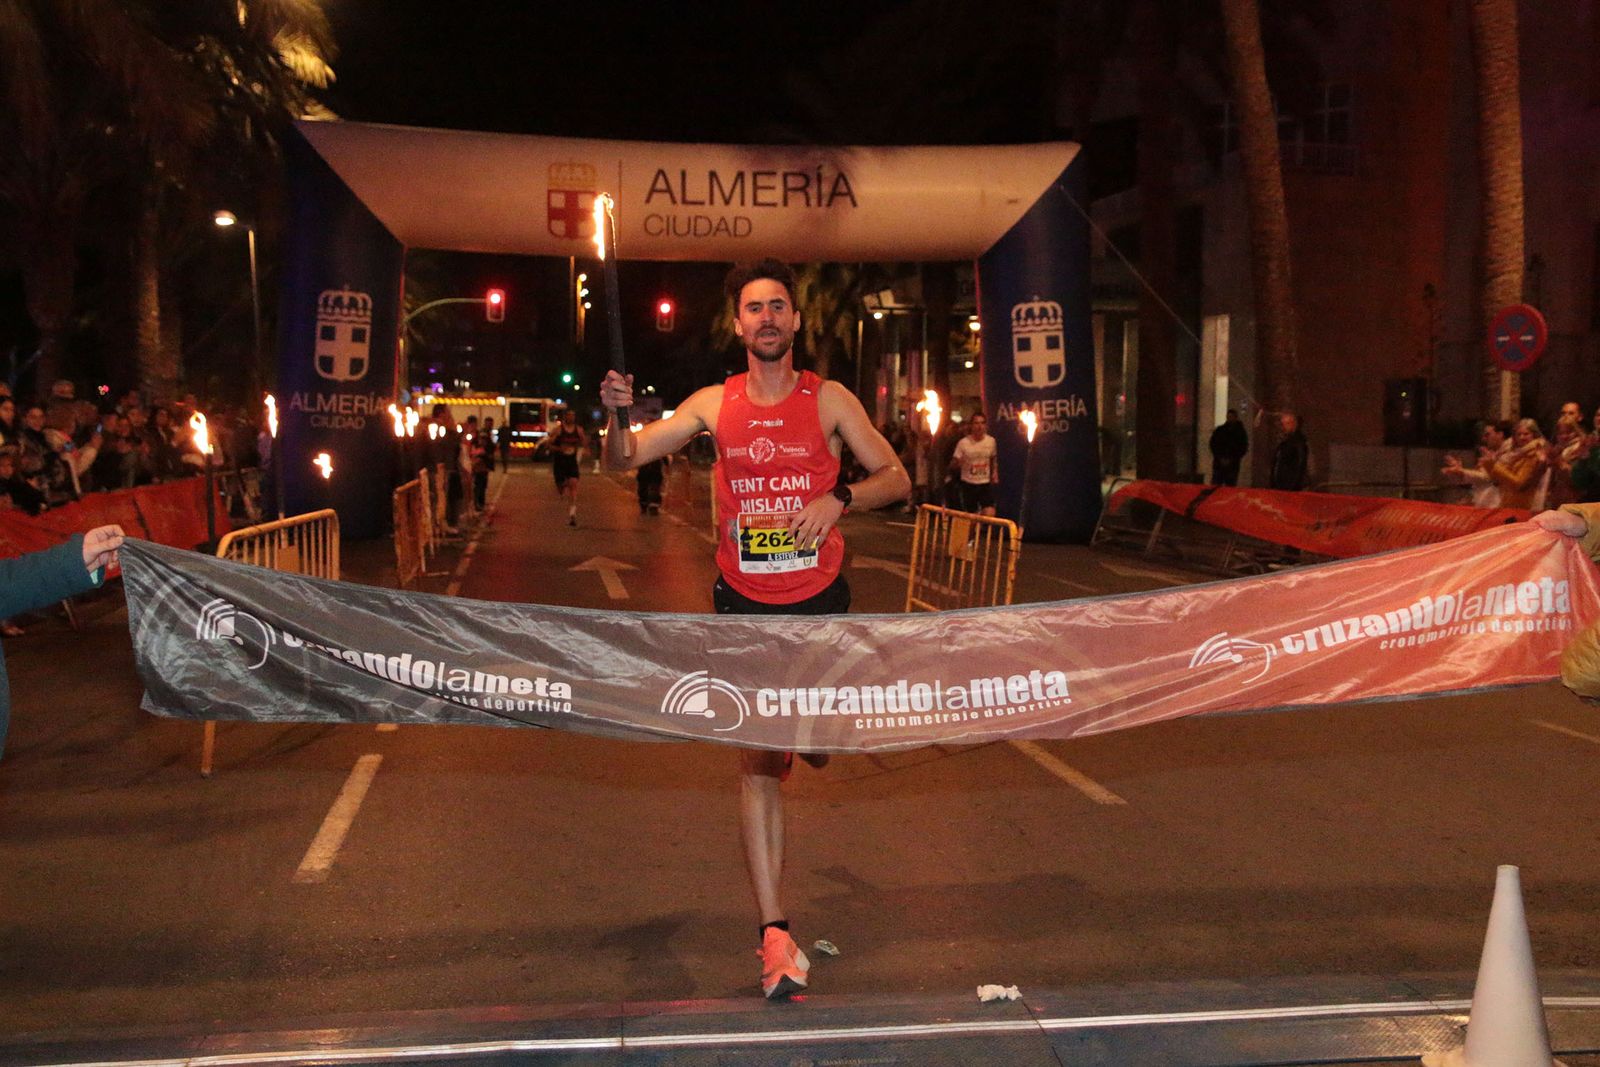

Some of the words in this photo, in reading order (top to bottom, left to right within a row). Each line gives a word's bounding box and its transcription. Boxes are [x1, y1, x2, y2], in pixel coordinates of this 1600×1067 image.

[645, 164, 858, 207] ALMERÍA
[644, 213, 752, 238] CIUDAD
[290, 391, 386, 415] ALMERÍA
[310, 414, 366, 430] CIUDAD
[731, 477, 765, 494] FENT
[769, 473, 810, 492] CAMÍ
[741, 496, 803, 513] MISLATA
[1280, 576, 1570, 655] cruzandolameta
[484, 696, 571, 713] deportivo
[757, 669, 1069, 717] cruzandolameta
[855, 710, 979, 729] cronometraje
[985, 698, 1072, 718] deportivo
